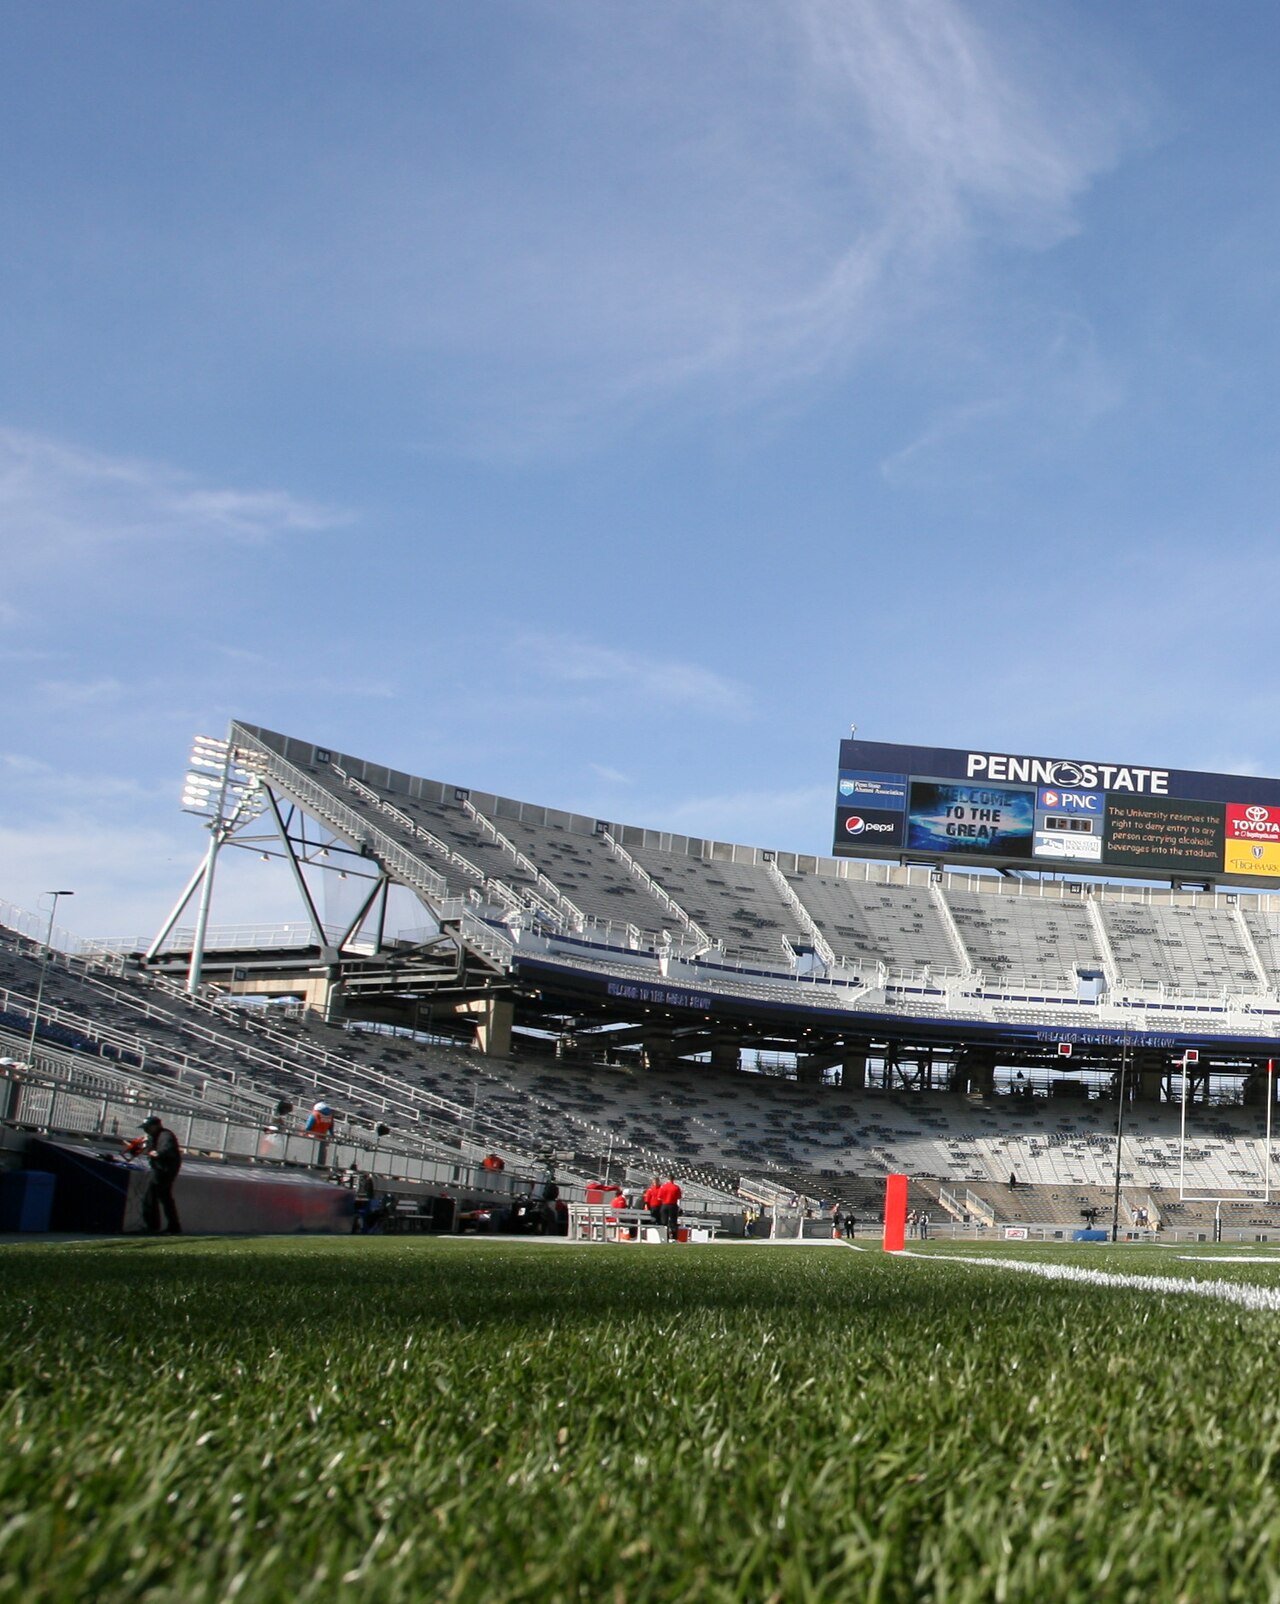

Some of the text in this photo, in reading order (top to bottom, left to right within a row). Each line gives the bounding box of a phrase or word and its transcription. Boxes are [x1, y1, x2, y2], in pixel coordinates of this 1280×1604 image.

[967, 754, 1169, 795] PENN STATE
[1061, 793, 1097, 809] PNC
[946, 805, 1001, 822] TO THE
[1109, 807, 1220, 824] The University reserves the
[865, 823, 894, 832] pepsi
[946, 822, 998, 838] GREAT
[1112, 820, 1132, 830] right
[1145, 822, 1165, 832] deny
[1167, 825, 1189, 834] entry
[1192, 826, 1200, 834] to
[1232, 819, 1280, 832] TOYOTA
[1113, 833, 1213, 846] person carrying alcoholic
[1108, 842, 1219, 858] beverages into the stadium.
